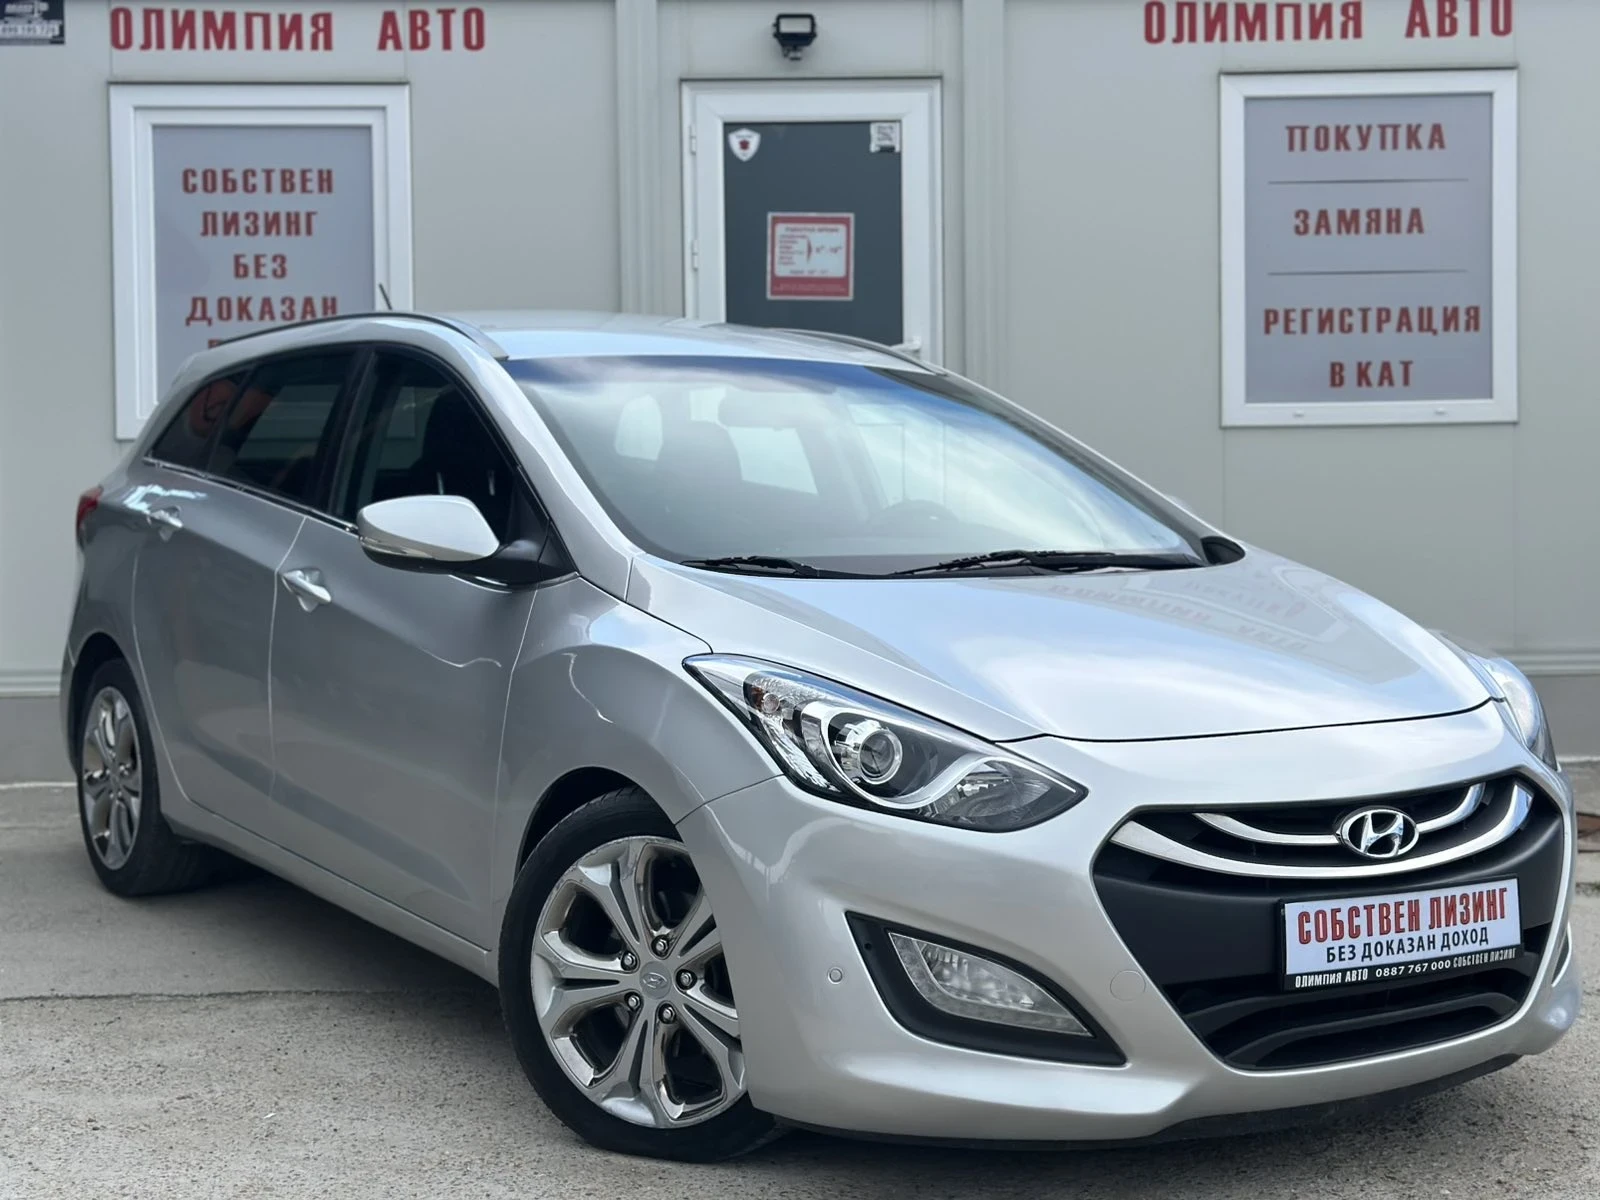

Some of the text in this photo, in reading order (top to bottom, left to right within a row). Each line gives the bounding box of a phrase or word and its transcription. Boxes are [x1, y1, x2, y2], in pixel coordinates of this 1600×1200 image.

[110, 7, 486, 51] ОЛИМПИЯ АВТО
[1143, 0, 1514, 44] ОЛИМПИЯ АВТО
[1285, 123, 1447, 152] ПОКУПКА
[182, 168, 334, 195] СОБСТВЕН
[200, 211, 318, 238] ЛИЗИНГ
[1293, 207, 1425, 236] ЗАМЯНА
[232, 253, 288, 280] БЕЗ
[185, 296, 338, 327] ДОКАЗАН
[1263, 305, 1481, 336] РЕГИСТРАЦИЯ
[1329, 360, 1414, 388] В КАТ
[1297, 887, 1508, 945] СОБСТВЕН ЛИЗИНГ
[1326, 926, 1489, 964] БЕЗ ДОКАЗАН ДОХОД
[1295, 947, 1516, 988] ОЛИМПИЯ АВТО 0887 767 000 СОБСТВЕН ЛИЗИНГ
